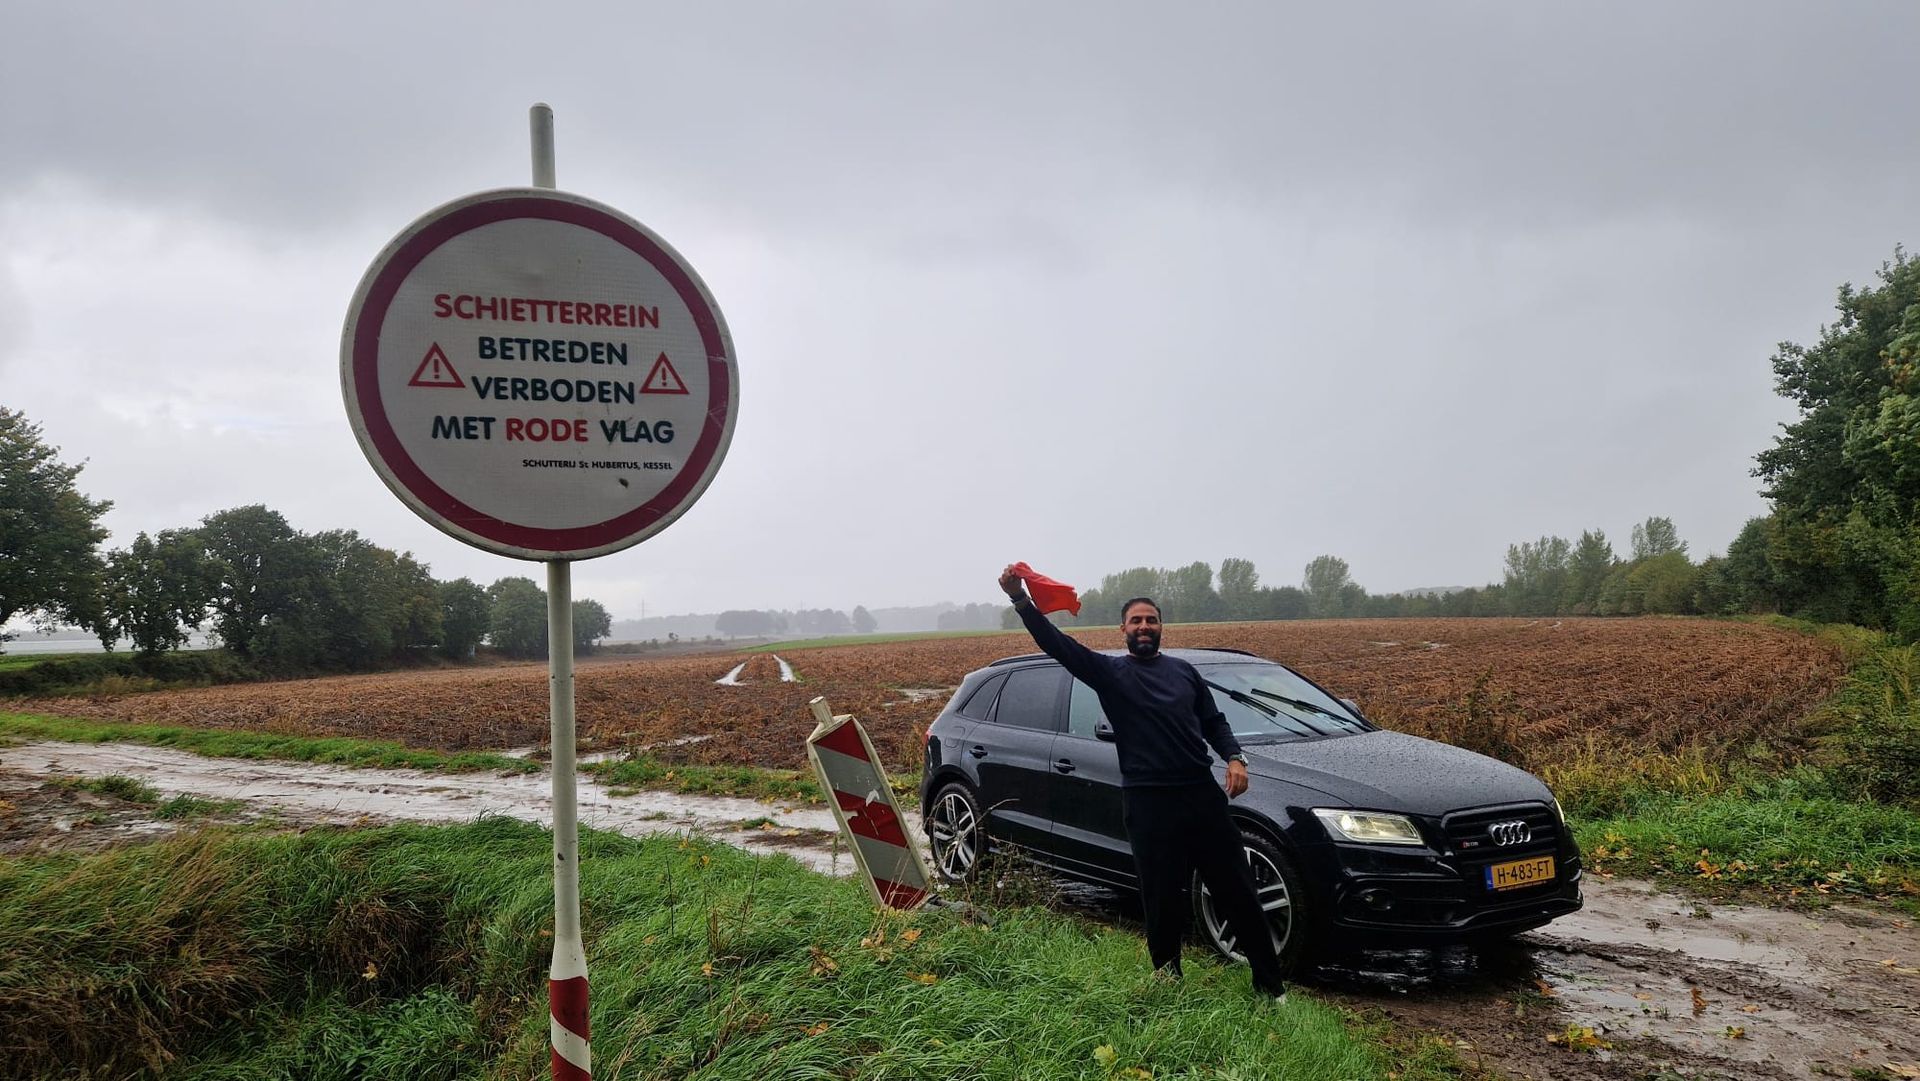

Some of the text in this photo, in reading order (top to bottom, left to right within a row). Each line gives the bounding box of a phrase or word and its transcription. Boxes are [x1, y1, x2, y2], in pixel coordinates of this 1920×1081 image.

[433, 294, 660, 329] SCHIETTERREIN
[477, 336, 628, 366] BETREDEN
[471, 375, 635, 404] VERBODEN
[431, 415, 675, 444] MET RODE VLAG
[522, 459, 576, 468] SCHUTTERIJ
[591, 460, 641, 470] HUBERTUS,
[643, 461, 673, 470] KESSEL
[1497, 860, 1550, 884] H-483-FT
